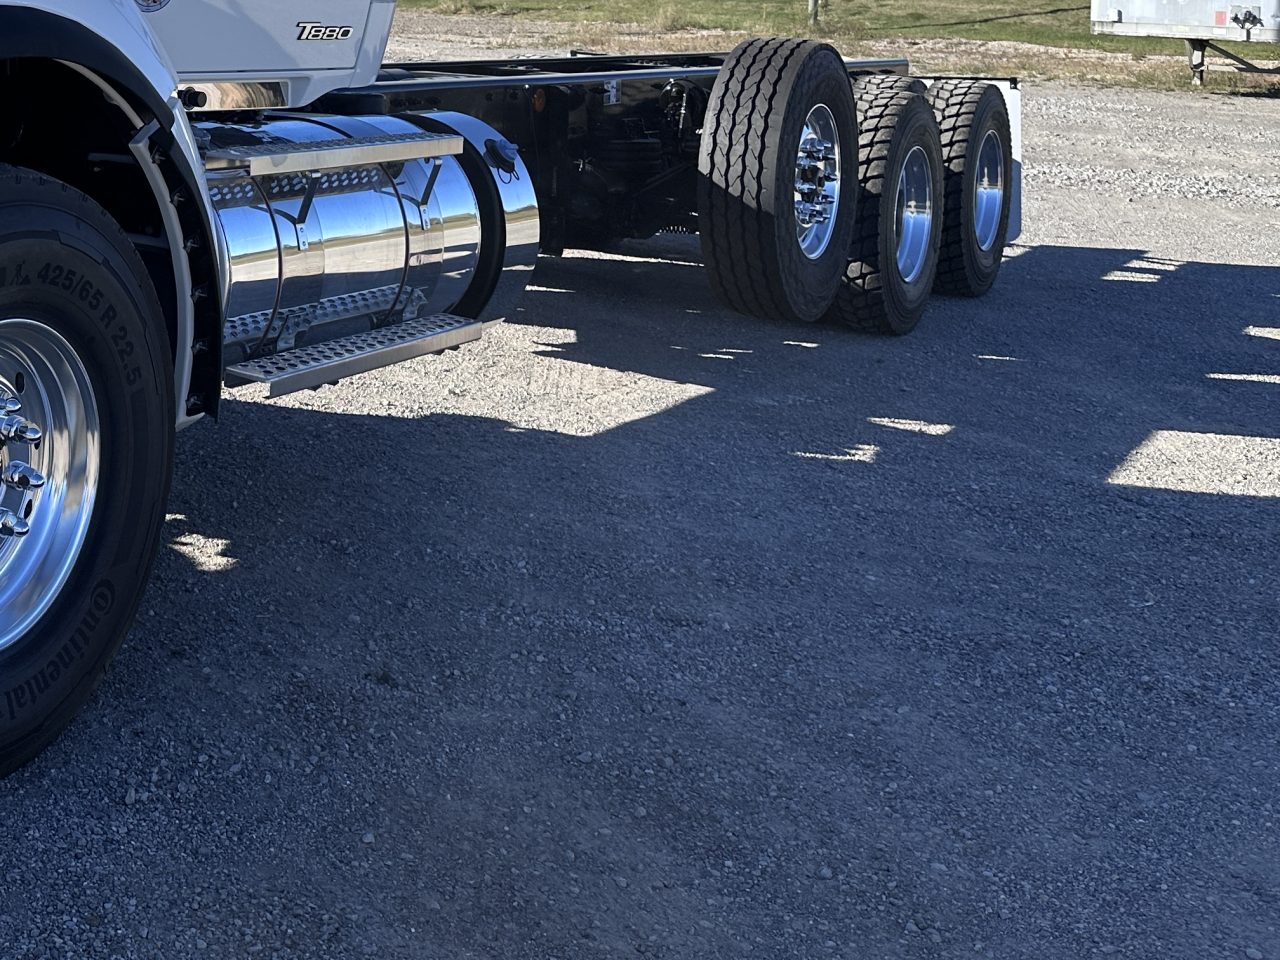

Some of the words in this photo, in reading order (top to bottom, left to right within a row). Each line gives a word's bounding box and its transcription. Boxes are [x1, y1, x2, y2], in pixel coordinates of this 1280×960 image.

[296, 21, 354, 40] T880
[37, 262, 104, 311] 425/65
[100, 303, 118, 330] R
[111, 325, 142, 386] 22.5
